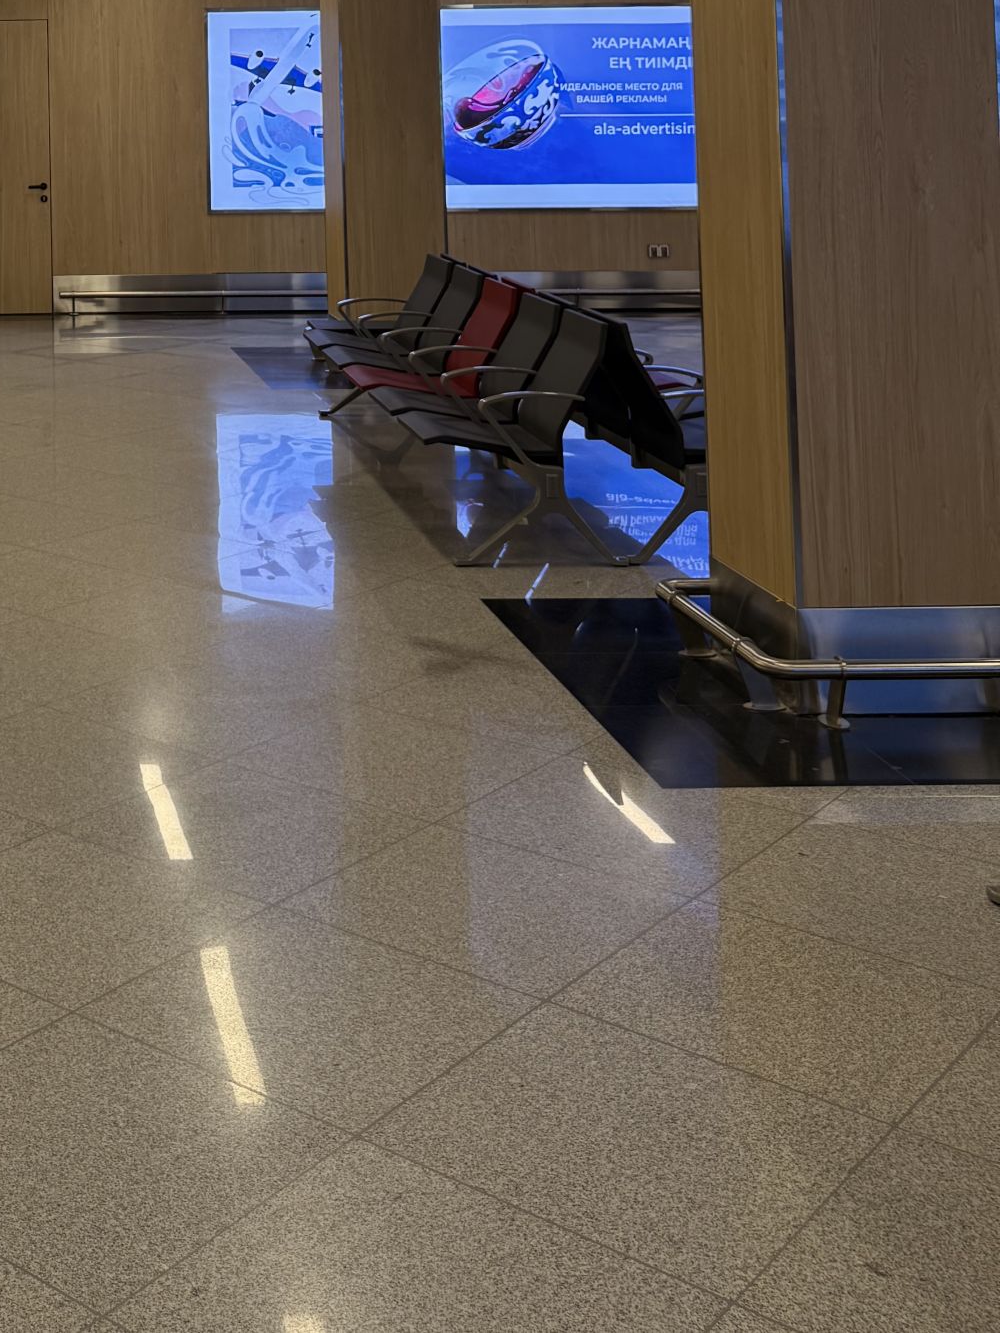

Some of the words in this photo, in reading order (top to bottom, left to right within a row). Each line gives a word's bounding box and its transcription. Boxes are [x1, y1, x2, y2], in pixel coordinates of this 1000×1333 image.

[609, 56, 632, 70] ЕҢ
[634, 56, 693, 70] ТИІМДІ
[560, 82, 623, 92] ИДЕАЛЬНОЕ
[624, 82, 659, 91] МЕСТО
[660, 82, 683, 92] ДЛЯ
[576, 93, 614, 103] ВАШЕЙ
[615, 94, 667, 103] РЕКЛАМЫ
